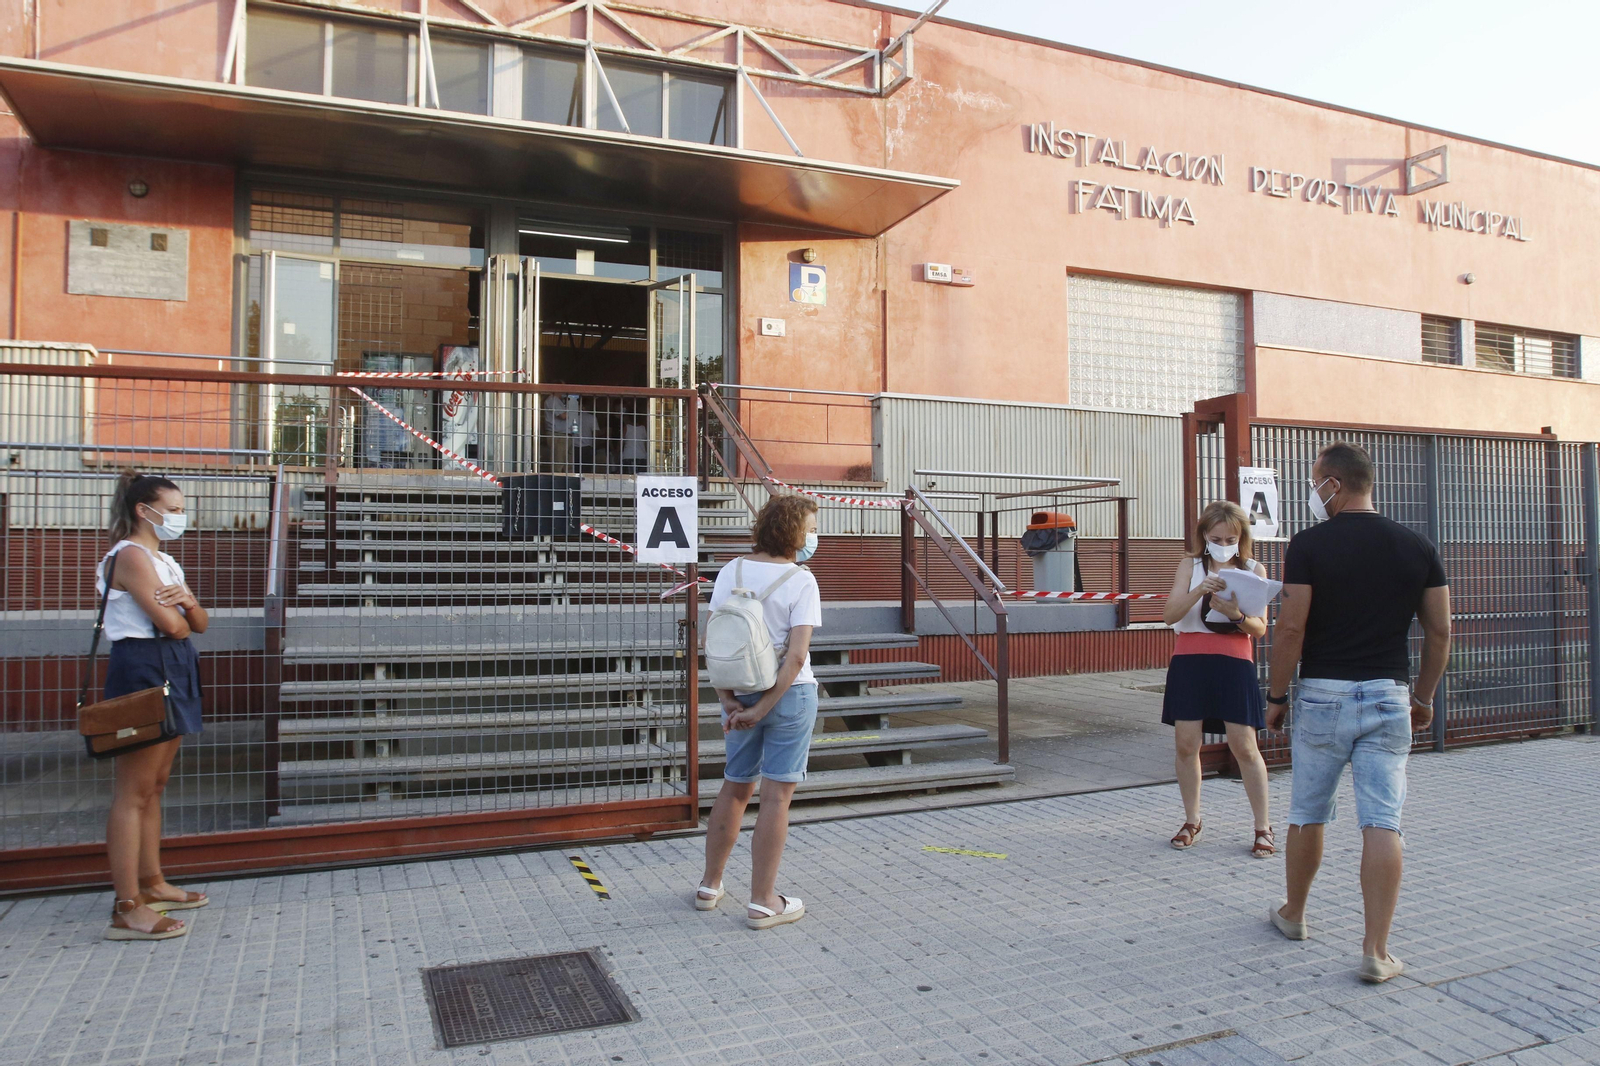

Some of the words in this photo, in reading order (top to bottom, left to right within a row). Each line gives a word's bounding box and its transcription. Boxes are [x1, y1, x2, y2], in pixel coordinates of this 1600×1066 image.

[1029, 121, 1226, 186] INSTALACION
[1251, 166, 1401, 218] DEPORTIVA
[1423, 198, 1533, 243] MUNICIPAL
[1076, 179, 1199, 229] FATIMA
[641, 487, 694, 498] ACCESO
[1242, 476, 1273, 485] ACCESO
[645, 506, 691, 549] A
[1248, 491, 1275, 526] A
